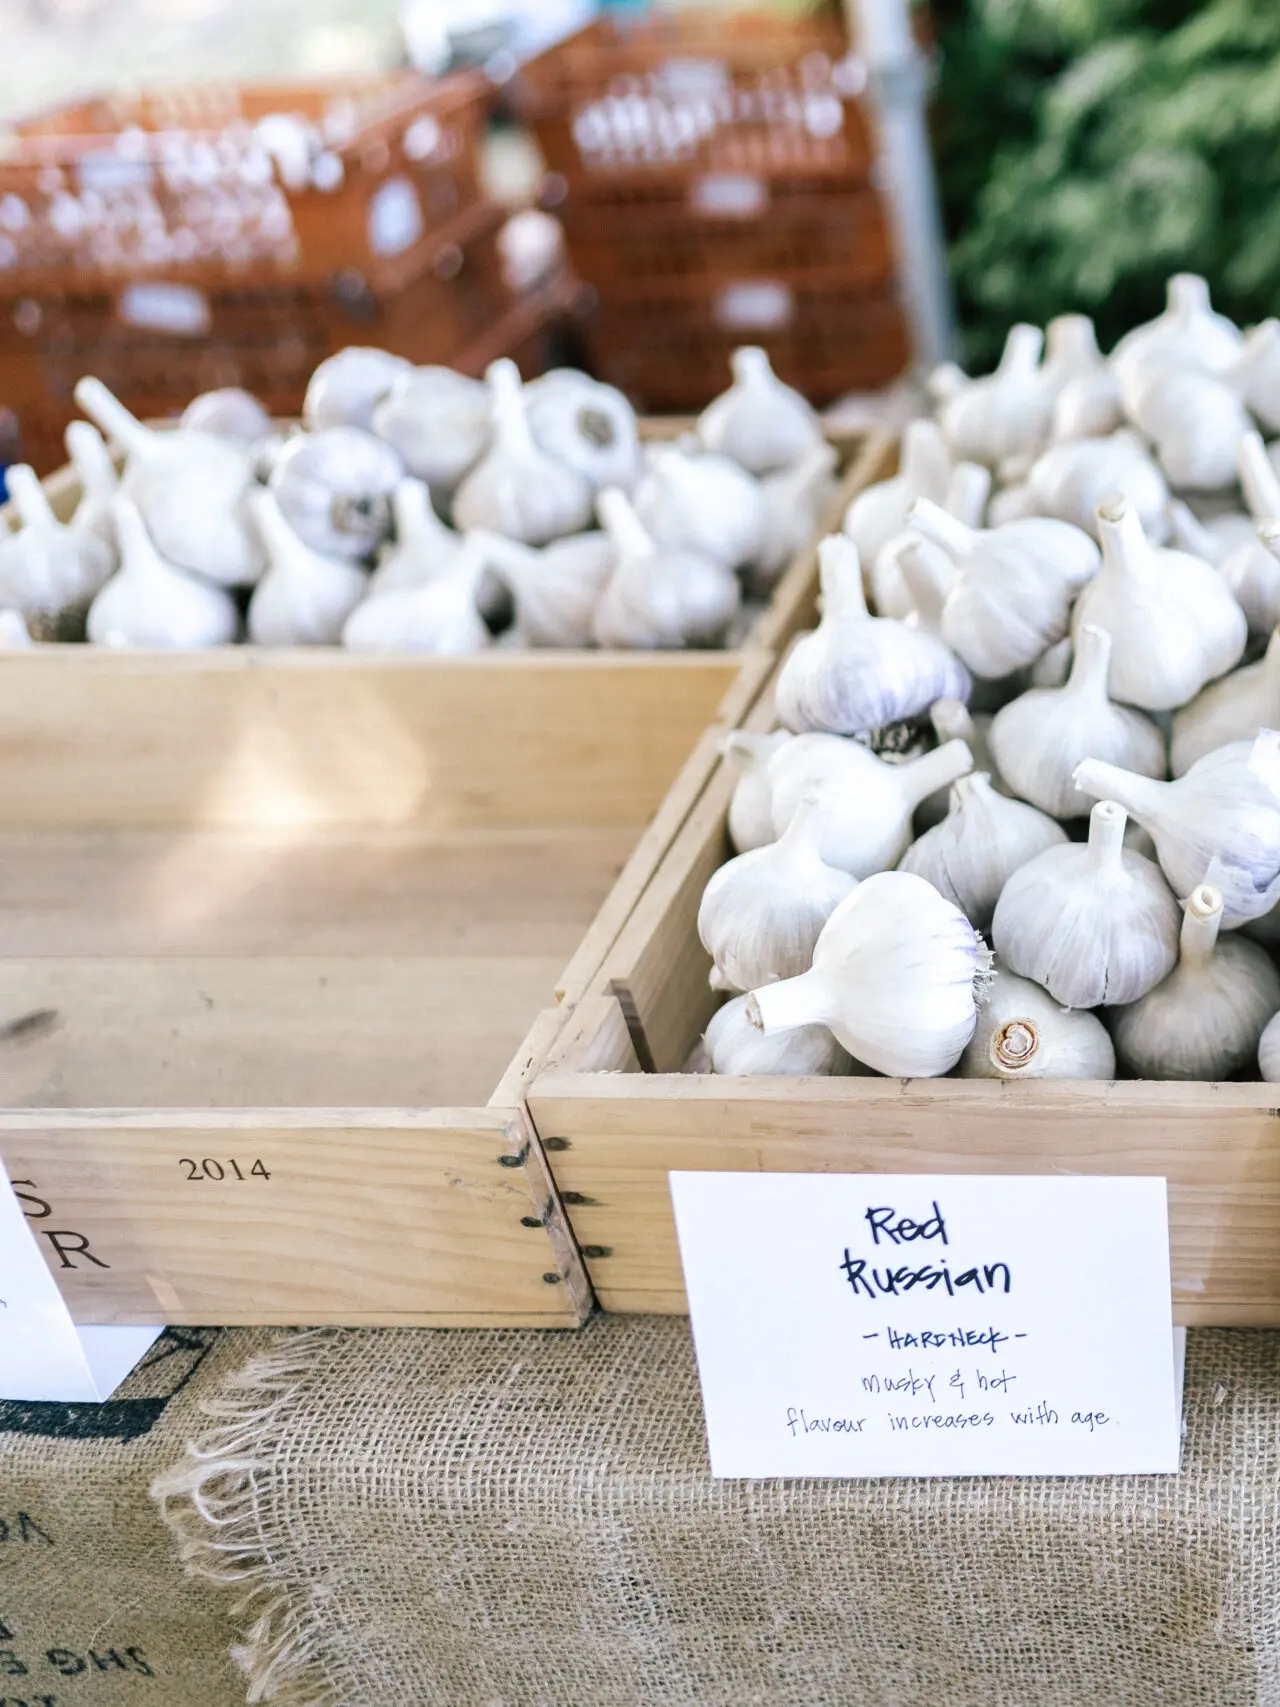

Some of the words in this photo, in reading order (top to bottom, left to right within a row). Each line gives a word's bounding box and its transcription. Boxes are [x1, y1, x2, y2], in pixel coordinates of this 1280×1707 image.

[178, 1158, 271, 1181] 2014
[864, 1200, 949, 1246] Red
[41, 1230, 111, 1269] R
[839, 1248, 1011, 1299] Russian
[862, 1369, 936, 1403] musky
[949, 1368, 965, 1399] &
[976, 1369, 1017, 1393] hot
[785, 1407, 867, 1436] flavour
[889, 1412, 995, 1432] increases
[1010, 1400, 1059, 1424] with
[1071, 1411, 1110, 1432] age
